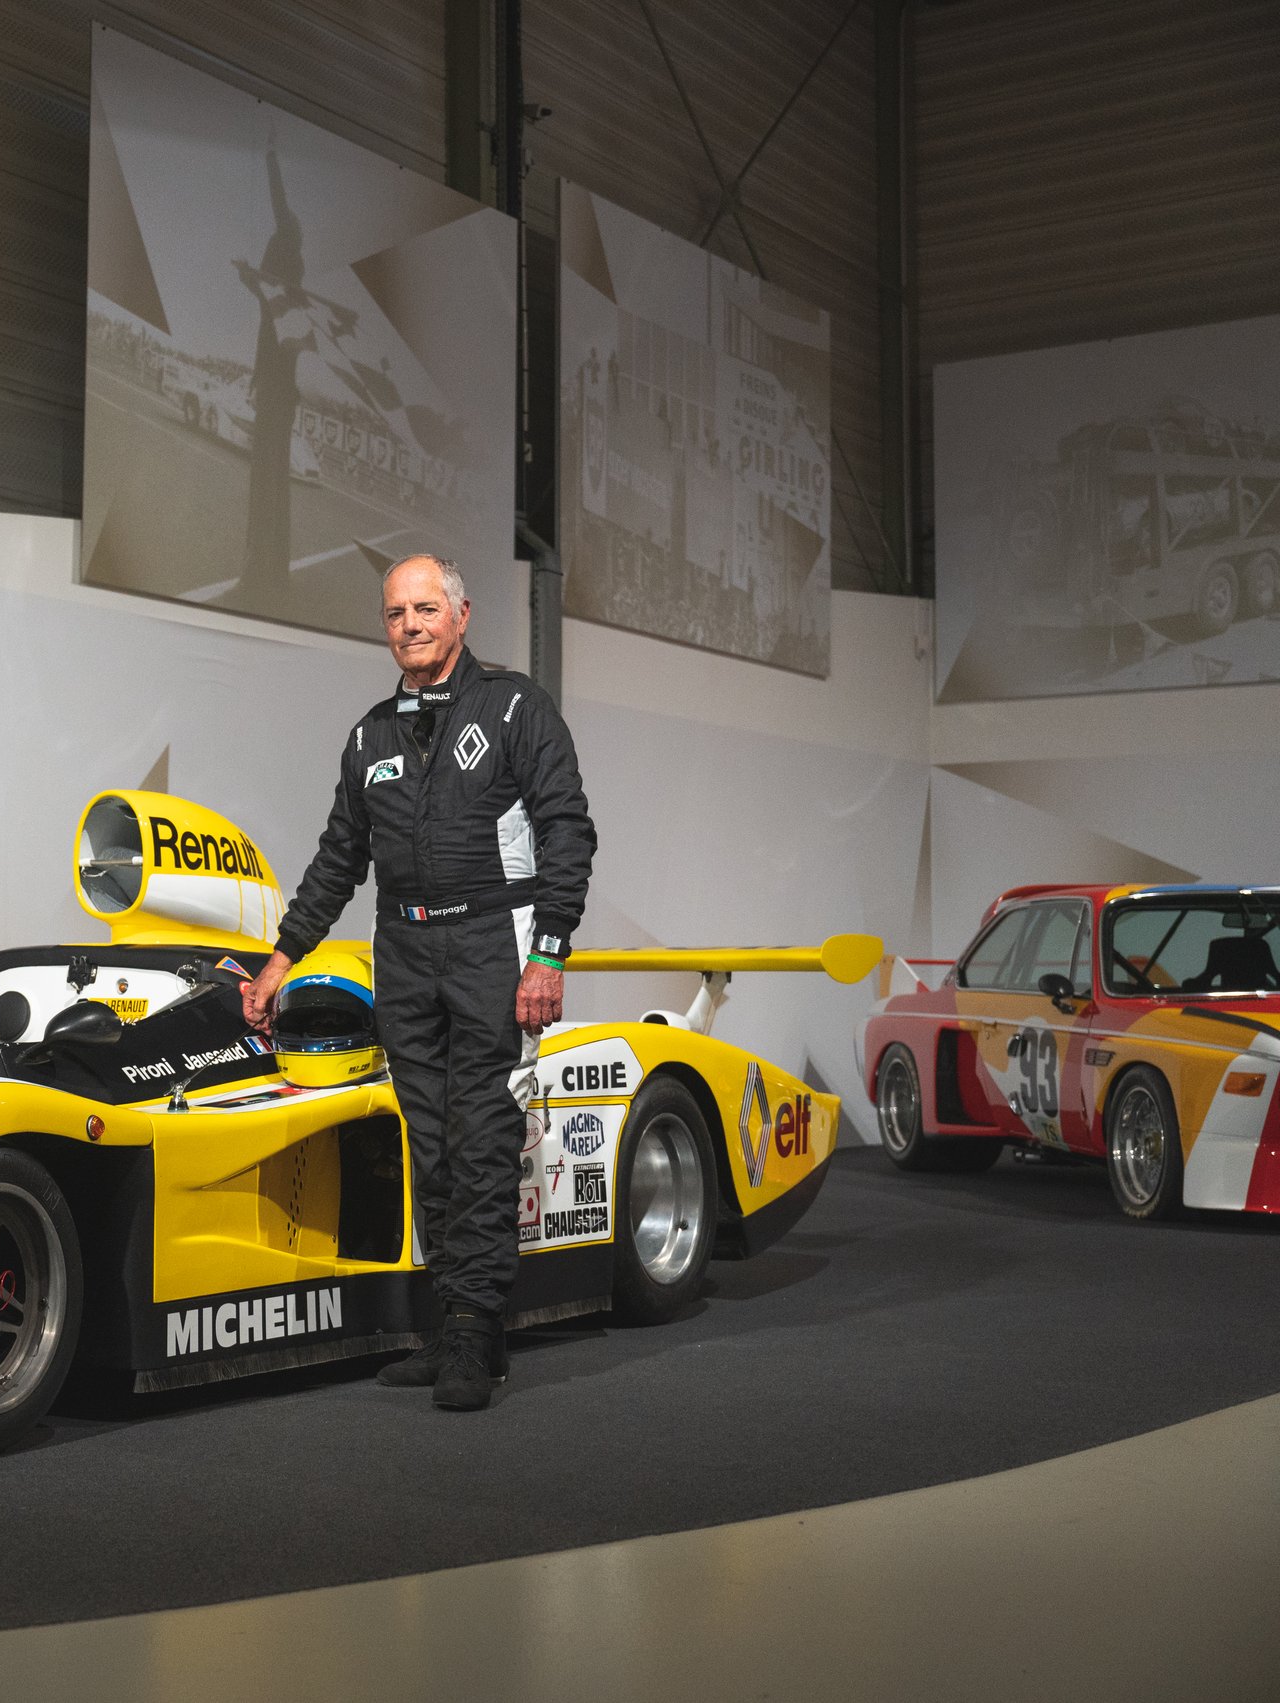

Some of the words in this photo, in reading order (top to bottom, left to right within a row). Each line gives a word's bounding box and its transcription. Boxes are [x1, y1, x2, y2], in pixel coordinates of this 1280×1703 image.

[739, 436, 826, 497] GIRLING
[422, 692, 451, 701] RENAULT
[148, 816, 264, 880] Renault
[111, 999, 148, 1013] RENAULT
[121, 1057, 176, 1083] Pironi
[1020, 1026, 1059, 1118] 93
[562, 1112, 604, 1138] MAGNETI
[775, 1093, 812, 1158] elf
[563, 1134, 605, 1157] MARELLI
[544, 1206, 609, 1240] CHAUSSON
[166, 1286, 343, 1358] MICHELIN
